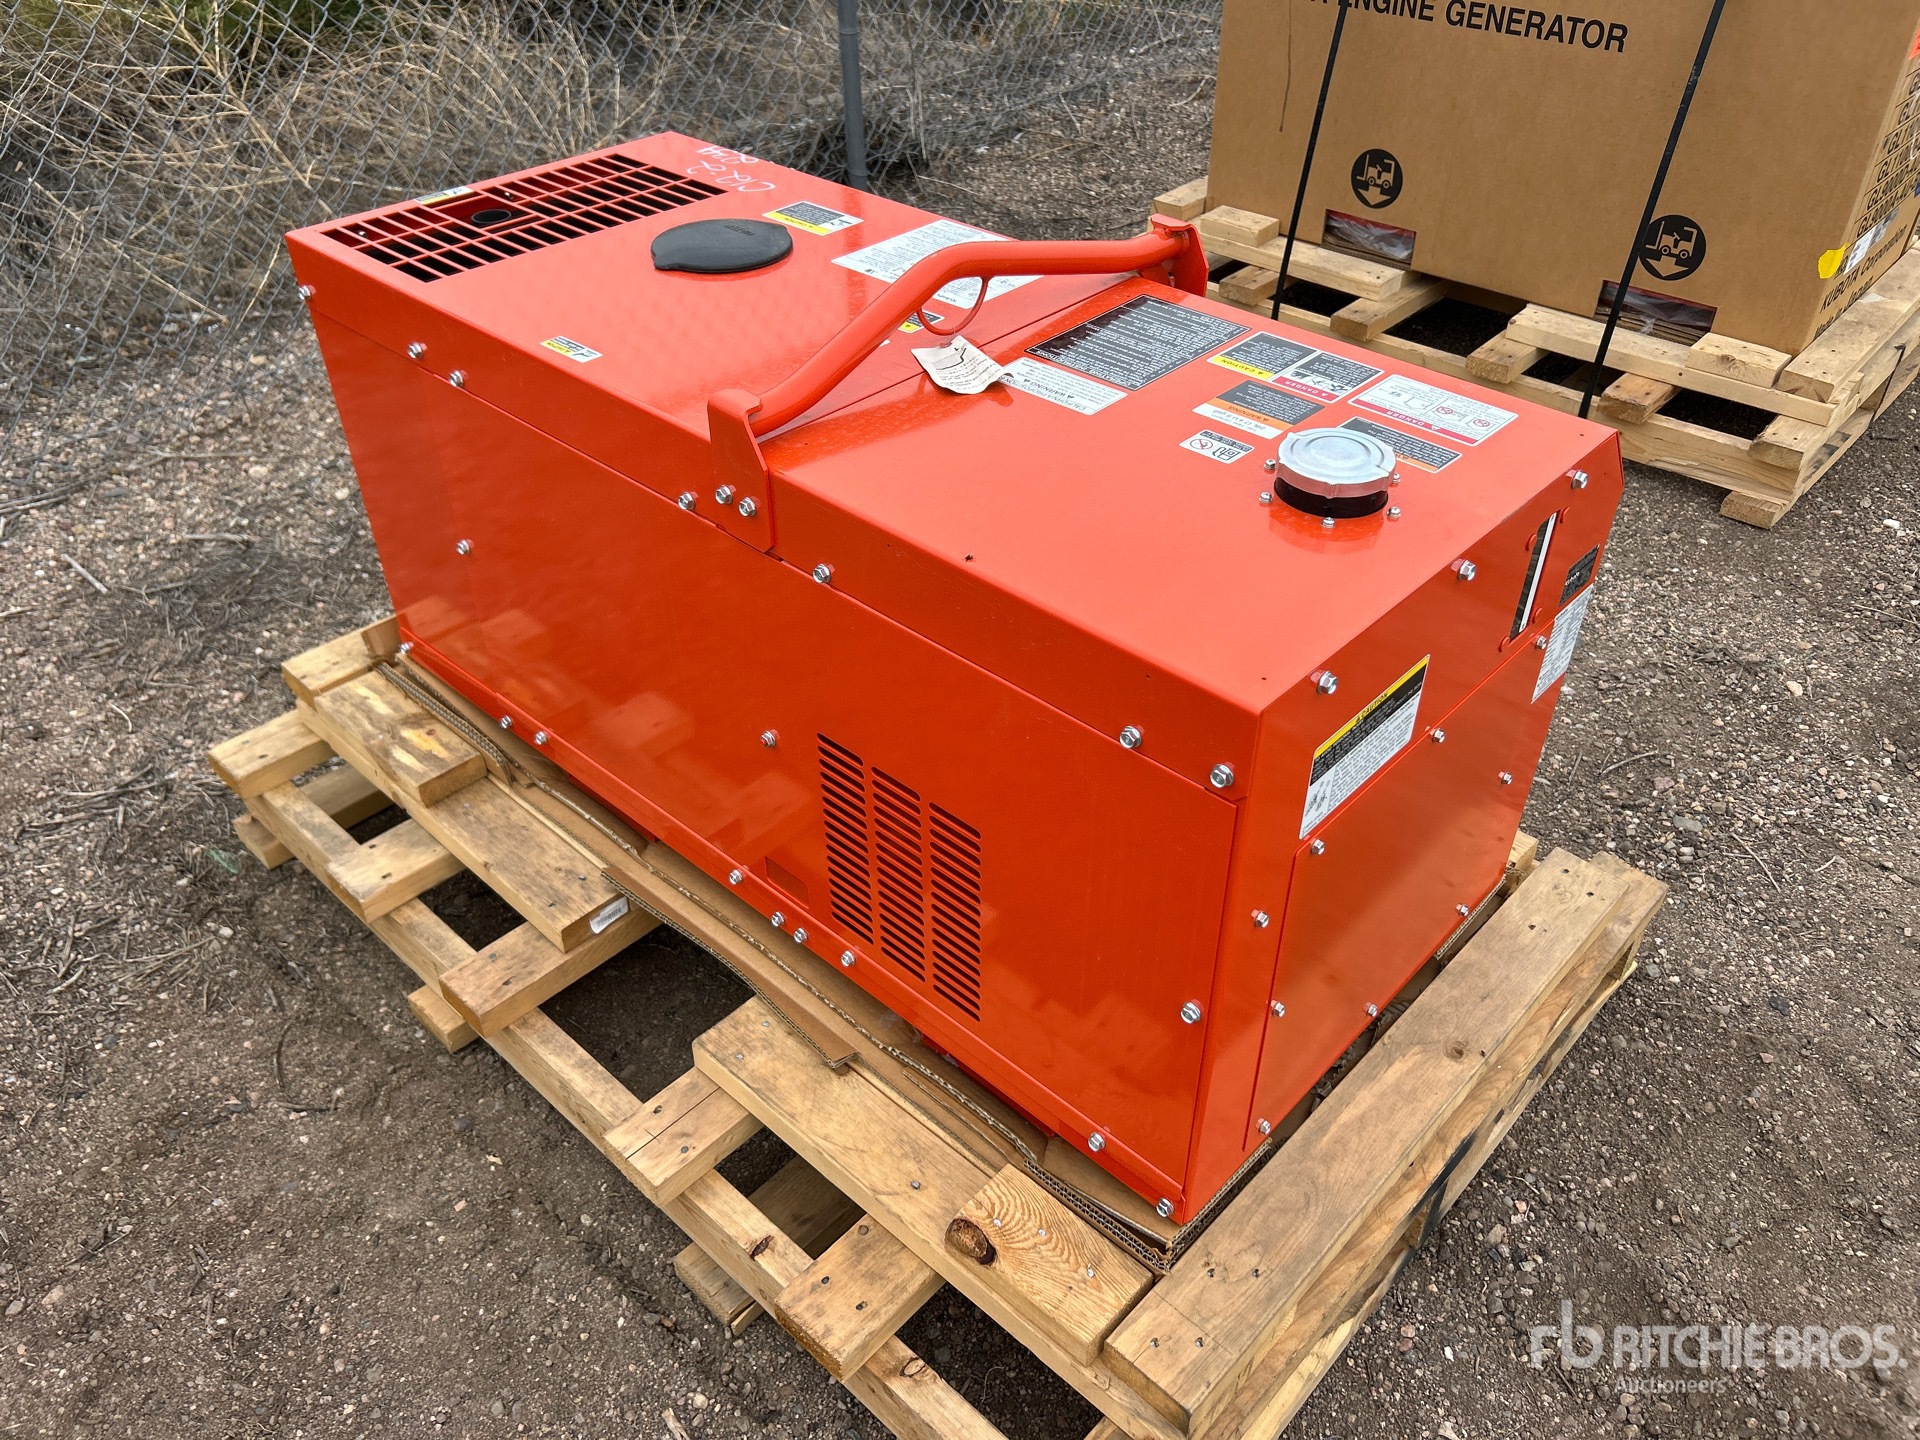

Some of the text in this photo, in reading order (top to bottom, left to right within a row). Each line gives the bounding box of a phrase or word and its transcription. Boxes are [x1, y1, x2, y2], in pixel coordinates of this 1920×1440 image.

[1339, 0, 1628, 53] GINE GENERATOR
[1820, 265, 1860, 314] KUBOTA
[1861, 224, 1907, 276] Corporation
[1221, 359, 1255, 374] CAUTION
[1030, 382, 1066, 397] WARNING
[1285, 380, 1318, 394] DANGER
[1228, 405, 1262, 421] WARNING
[1386, 411, 1425, 427] DANGER
